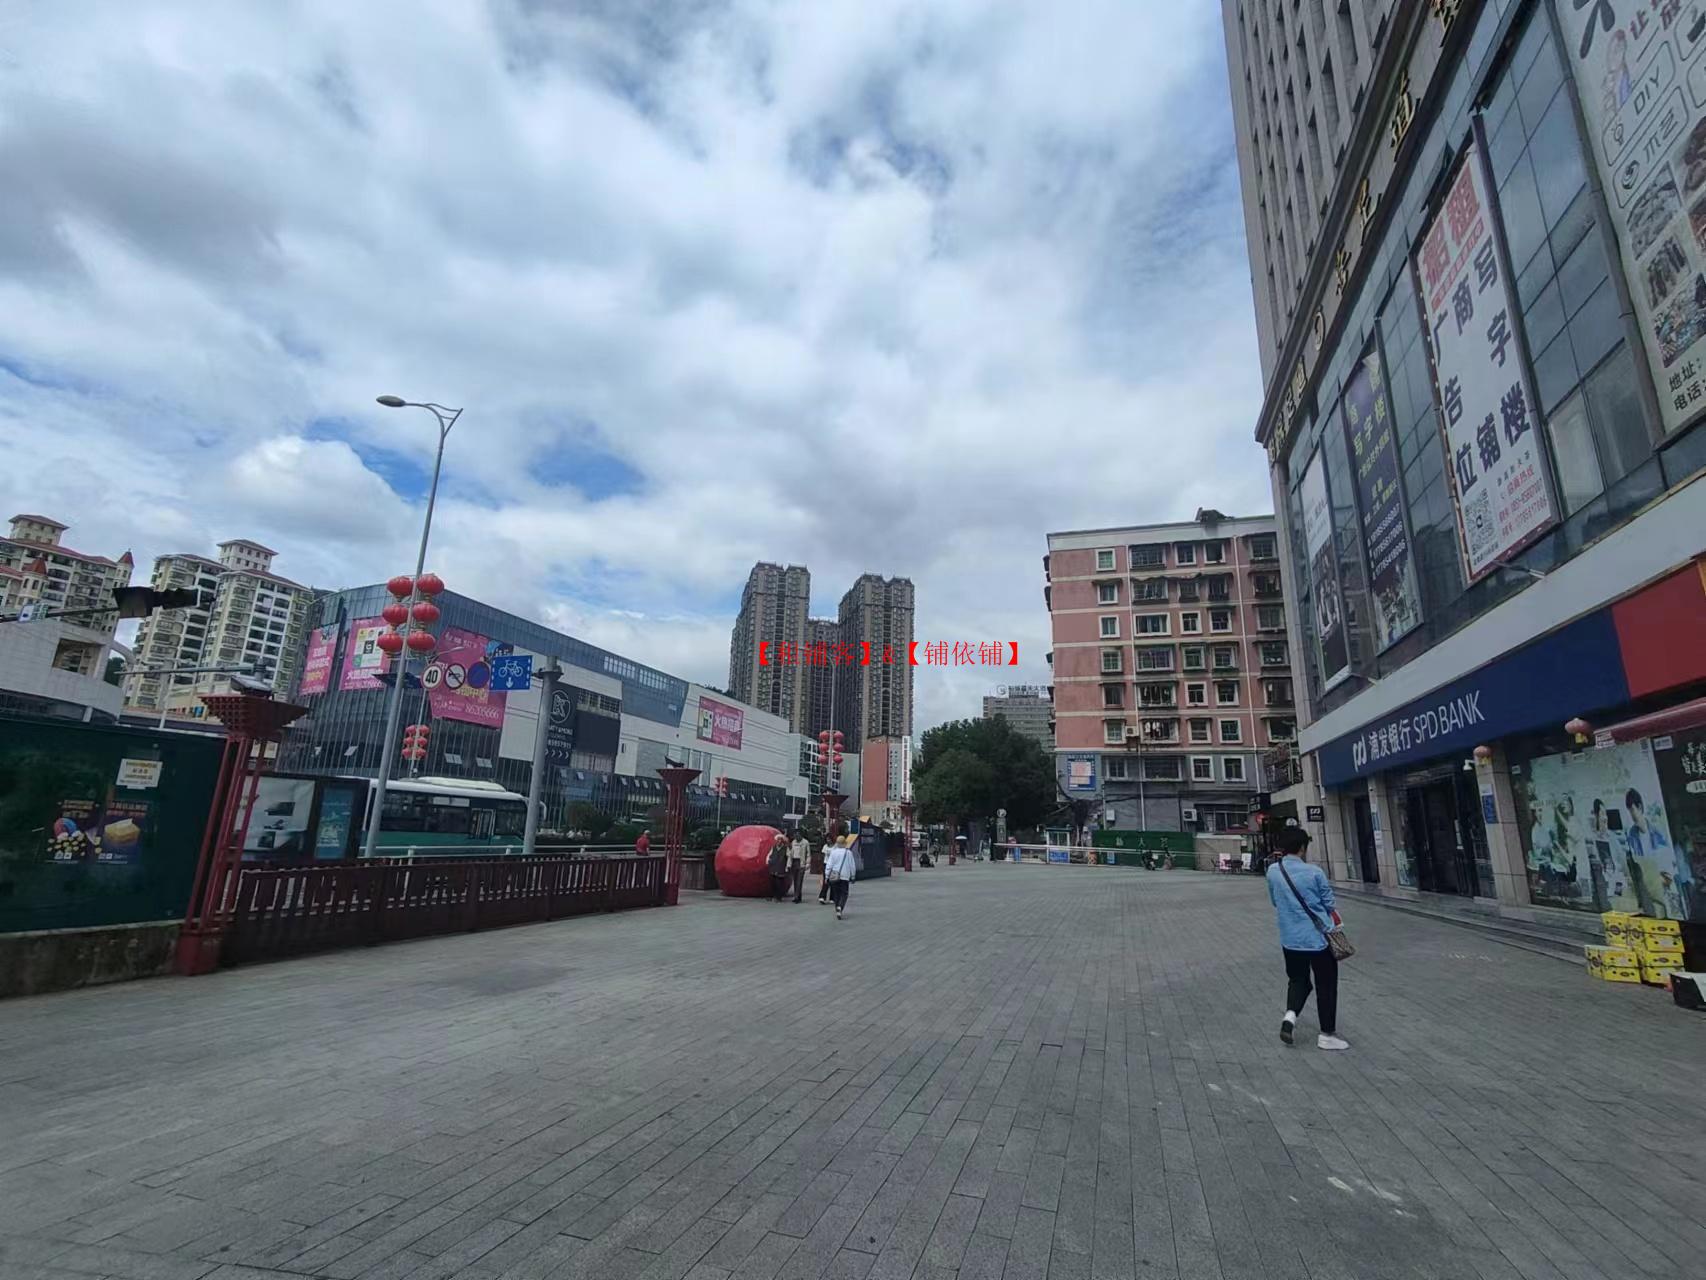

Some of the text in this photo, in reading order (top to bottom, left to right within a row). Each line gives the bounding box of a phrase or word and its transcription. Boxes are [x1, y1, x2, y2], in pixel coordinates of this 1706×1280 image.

[1633, 65, 1660, 116] DIY
[425, 669, 439, 684] 40
[1368, 689, 1486, 761] 浦发银行 SPD BANK
